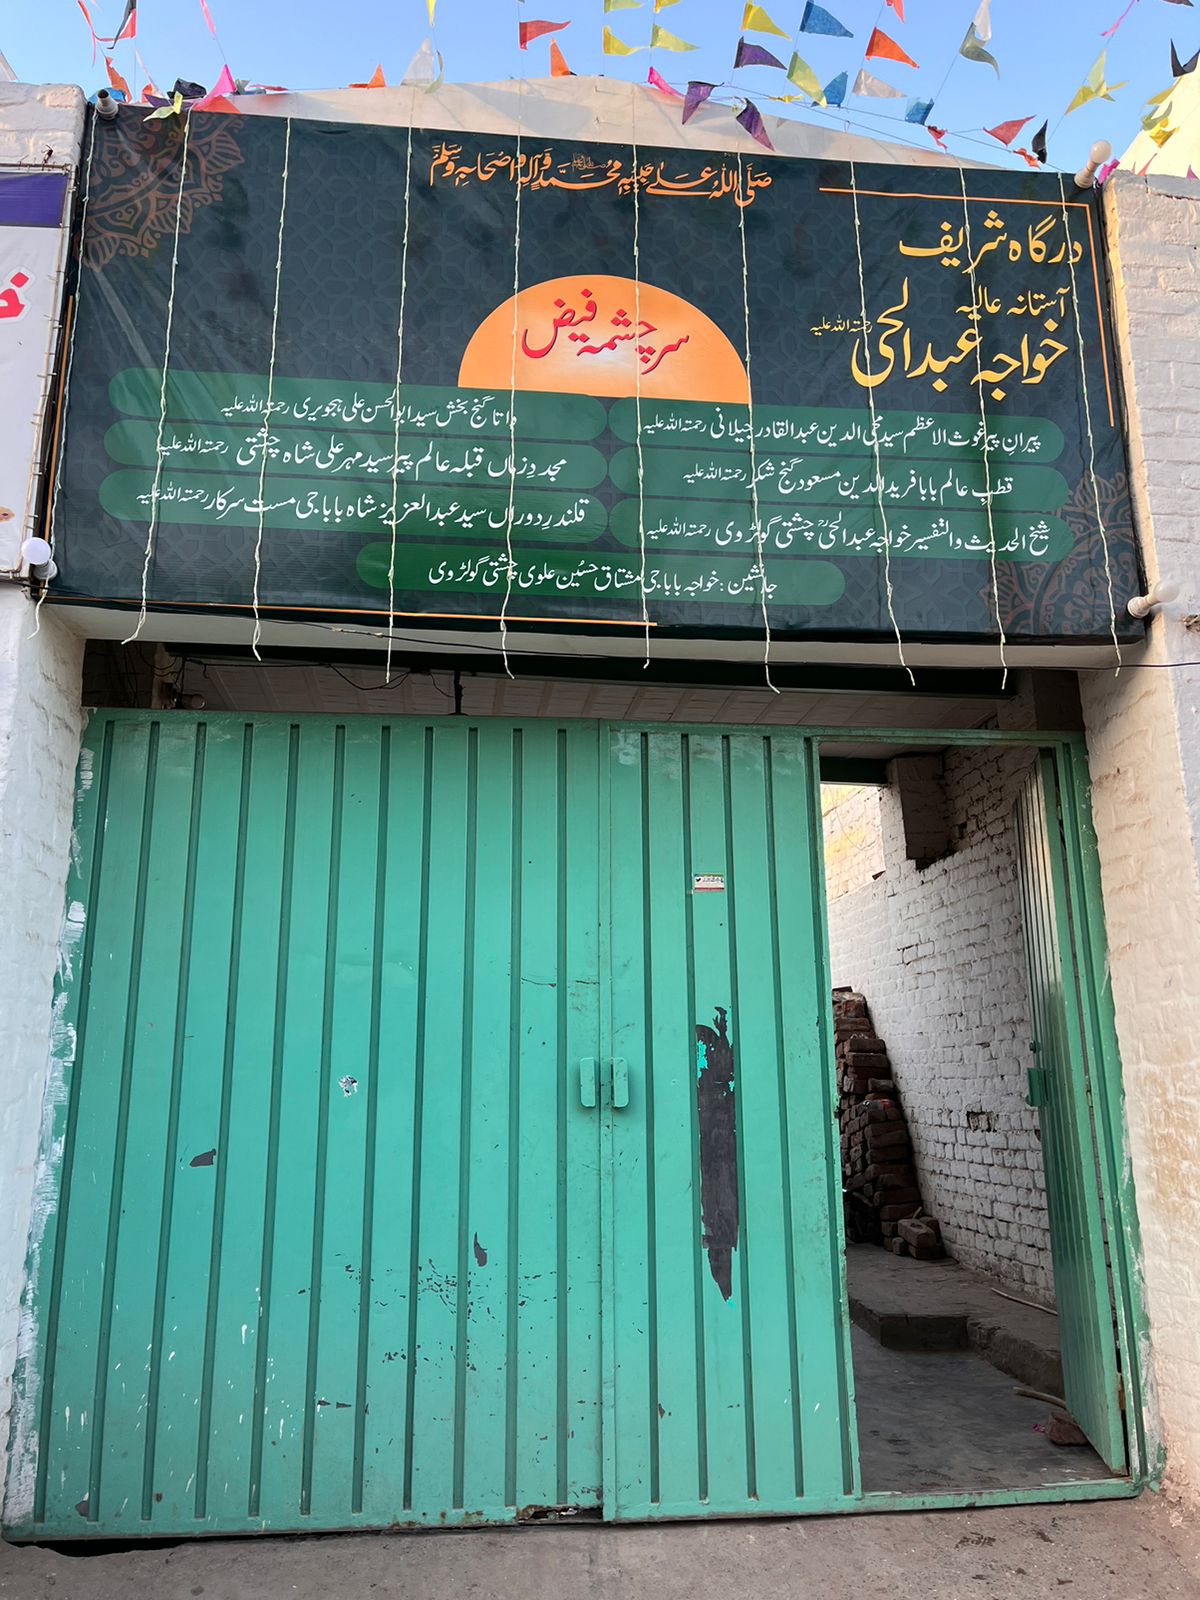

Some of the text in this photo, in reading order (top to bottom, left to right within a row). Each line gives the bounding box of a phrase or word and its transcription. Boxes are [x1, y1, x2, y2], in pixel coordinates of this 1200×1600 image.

[899, 210, 1083, 274] درگاہ شریف
[956, 285, 1071, 320] آستانہ عالیہ
[521, 288, 598, 359] فیض
[810, 316, 833, 336] علیہ
[832, 314, 850, 333] اللہ
[851, 277, 1068, 401] خواجہ عبدالحی
[221, 396, 244, 417] علیہ
[242, 393, 262, 413] اللہ
[293, 396, 343, 423] ہجویری
[341, 391, 364, 422] علی
[361, 388, 411, 424] ابوالحسن
[435, 398, 469, 427] بخش
[469, 396, 495, 429] گنج
[410, 409, 438, 427] سید
[491, 408, 517, 428] داتا
[643, 414, 665, 435] علیہ
[664, 412, 682, 432] اللہ
[710, 407, 753, 442] جیلانی
[755, 419, 818, 443] عبدالقادر
[180, 433, 201, 452] اللہ
[236, 427, 281, 465] چشتی
[816, 422, 860, 447] الدین
[880, 430, 904, 447] سید
[903, 416, 946, 453] الاعظم
[948, 421, 985, 447] غوث
[980, 432, 1000, 451] پیر
[283, 441, 316, 463] شاہ
[315, 435, 344, 468] علی
[331, 451, 363, 473] مہر
[359, 453, 395, 473] سید
[387, 452, 414, 474] پیر
[415, 441, 450, 481] عالم
[449, 447, 484, 478] قبلہ
[683, 463, 705, 484] علیہ
[704, 461, 722, 480] اللہ
[746, 458, 775, 489] شکر
[778, 458, 803, 494] گنج
[797, 471, 841, 492] مسعود
[136, 483, 161, 504] علیہ
[159, 481, 181, 500] اللہ
[838, 473, 885, 499] الدین
[887, 469, 916, 499] فرید
[918, 476, 937, 501] بابا
[940, 468, 968, 505] عالم
[203, 486, 245, 520] سرکار
[244, 496, 296, 512] مست
[295, 491, 319, 519] جی
[323, 495, 343, 522] بابا
[346, 495, 378, 517] شاہ
[378, 493, 460, 526] عبدالعزیز
[456, 508, 487, 528] سید
[488, 505, 542, 528] دوراں
[647, 519, 669, 540] علیہ
[668, 516, 686, 536] اللہ
[715, 515, 783, 546] گولڑوی
[775, 512, 814, 548] چشتی
[869, 524, 911, 553] خواجہ
[903, 517, 962, 552] والتفسیر
[964, 528, 1026, 553] الحدیث
[1029, 520, 1050, 556] شیخ
[428, 555, 490, 584] گولڑوی
[482, 553, 518, 587] چشتی
[518, 562, 555, 588] علوی
[594, 565, 642, 591] مشتاق
[643, 569, 661, 593] جی
[664, 573, 682, 596] بابا
[683, 570, 719, 597] خواجہ
